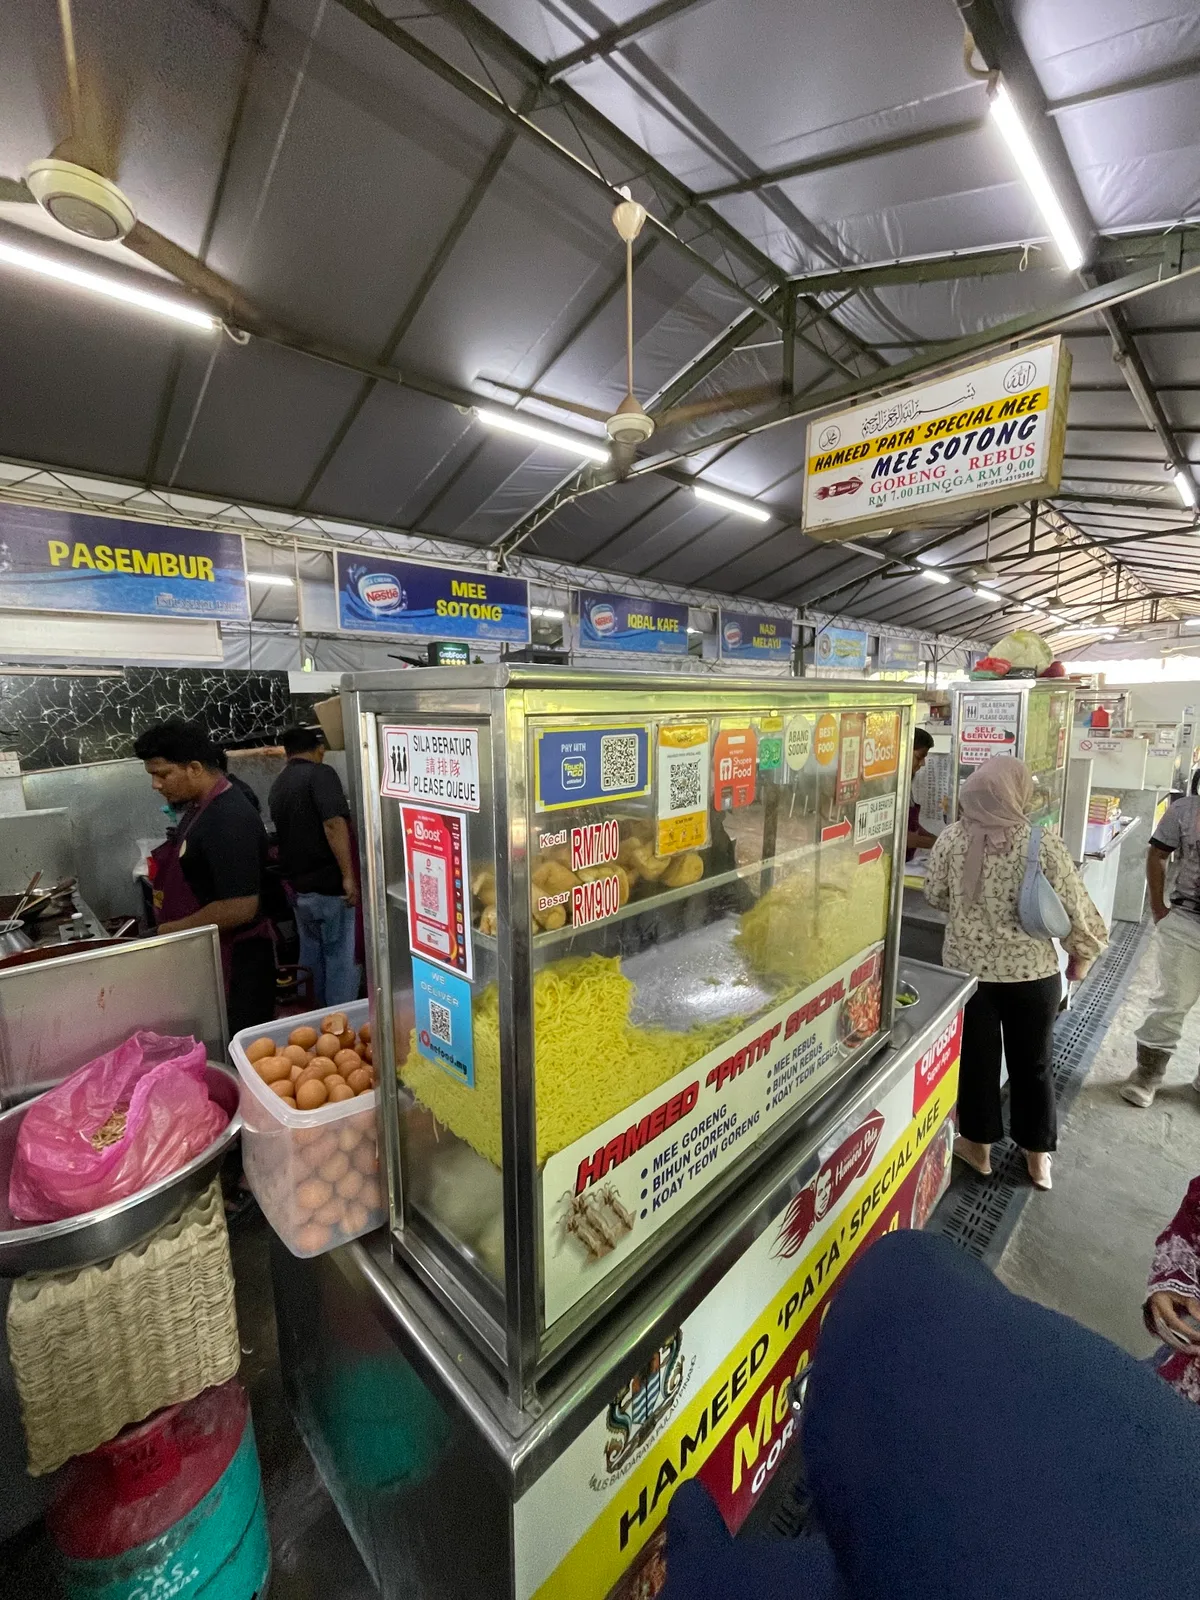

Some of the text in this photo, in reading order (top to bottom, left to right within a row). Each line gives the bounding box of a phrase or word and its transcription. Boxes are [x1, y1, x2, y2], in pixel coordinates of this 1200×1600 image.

[814, 442, 870, 472] HAMEED
[924, 405, 994, 439] SPECIAL
[998, 392, 1042, 418] MEE
[871, 414, 1038, 479] MEE SOTONG
[868, 458, 1035, 507] RM 7.00 HINGGA RM 9.00
[870, 442, 1036, 494] GORENG REBUS
[48, 540, 215, 582] PASEMBUR
[436, 599, 502, 622] SOTONG
[452, 580, 487, 600] MEE
[627, 613, 656, 631] IQBAL
[657, 617, 679, 633] KAFE
[413, 735, 472, 757] SILA BERATUR
[788, 730, 809, 742] ABANG
[413, 776, 476, 801] PLEASE QUEUE
[563, 762, 584, 771] Touch
[733, 764, 752, 779] Food
[539, 829, 567, 848] Kecil
[539, 874, 620, 929] Besar RM9.00
[420, 981, 460, 1008] DELIVER
[431, 972, 445, 985] WE
[772, 1042, 823, 1092] BIHUN REBUS
[773, 1033, 816, 1076] MEE REBUS
[921, 1015, 958, 1076] airasia
[574, 1080, 700, 1198] HAMEED
[784, 977, 847, 1042] SPECIAL
[771, 1082, 794, 1109] KOAY
[795, 1062, 816, 1088] TEOW
[652, 1103, 727, 1173] MEE GORENG
[652, 1112, 737, 1192] BIHUN GORENG
[652, 1110, 760, 1212] KOAY TEOW GORENG
[835, 1140, 863, 1186] Hameed
[619, 1333, 770, 1552] HAMEED
[850, 1141, 913, 1241] SPECIAL
[916, 1098, 941, 1148] MEE
